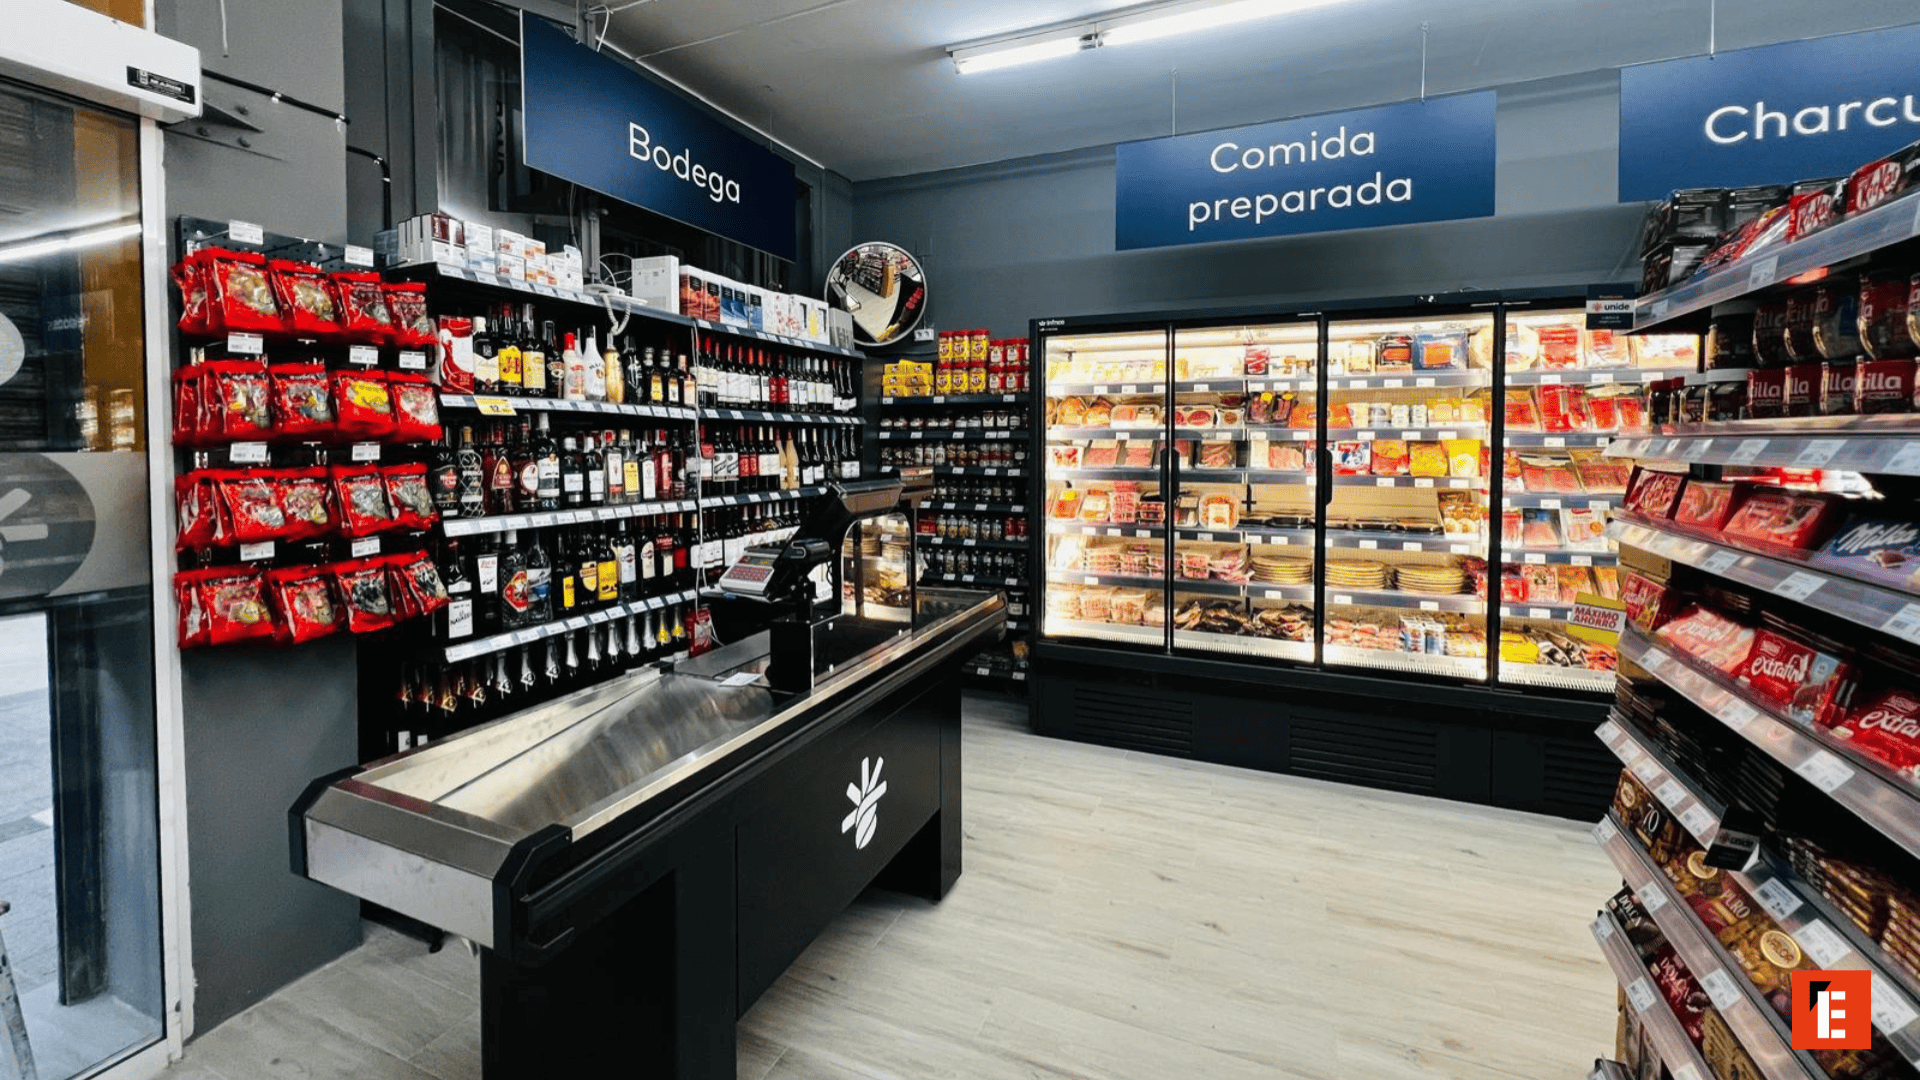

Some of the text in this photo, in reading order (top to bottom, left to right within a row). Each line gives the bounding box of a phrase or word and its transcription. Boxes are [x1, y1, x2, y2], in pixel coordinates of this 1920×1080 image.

[629, 121, 740, 204] Bodega
[1210, 125, 1376, 173] Comida
[1188, 171, 1412, 232] preparada
[1604, 302, 1630, 311] unide
[1835, 521, 1918, 554] Milka
[1572, 614, 1617, 629] AHORRO
[1574, 606, 1620, 622] MÁXIMO
[1642, 803, 1660, 833] 70
[1722, 888, 1751, 919] PURO
